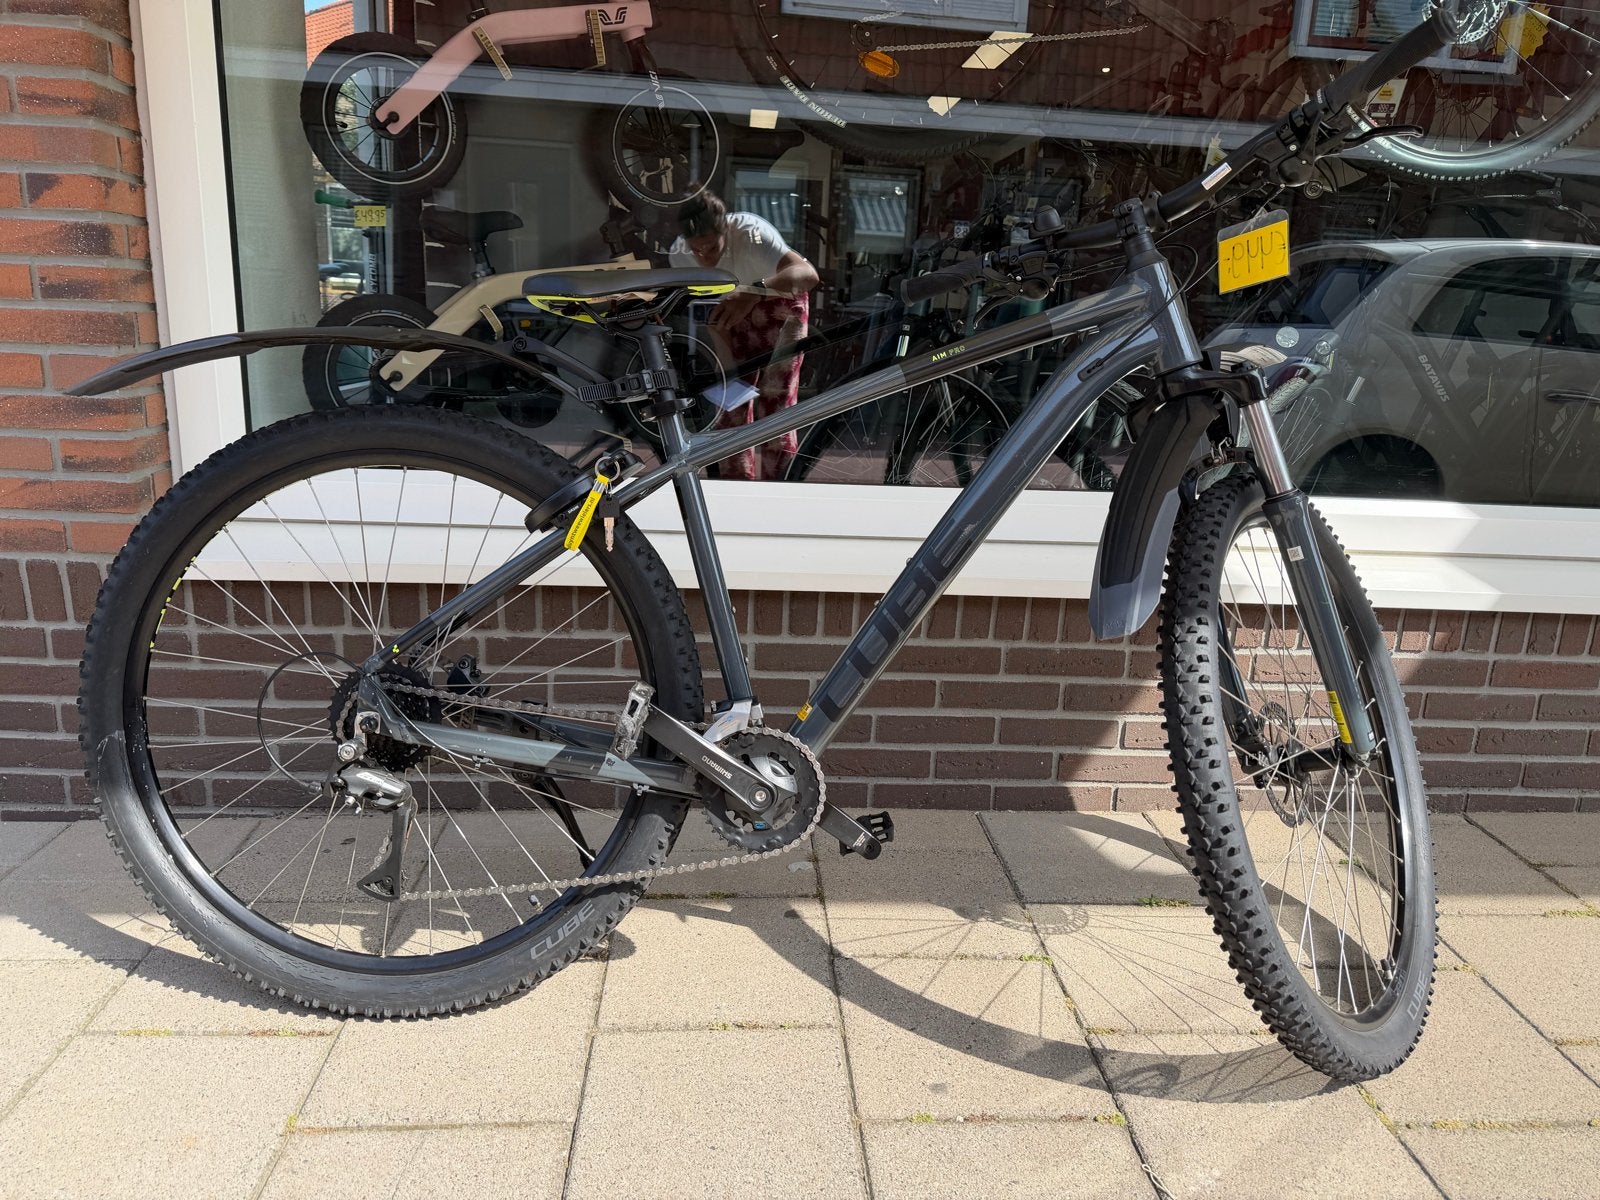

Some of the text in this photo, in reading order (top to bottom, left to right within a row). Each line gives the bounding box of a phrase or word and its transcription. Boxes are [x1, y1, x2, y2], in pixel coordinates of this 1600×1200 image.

[932, 345, 966, 362] AIM PRO
[1418, 354, 1450, 402] BATAVUS
[818, 518, 973, 722] CUBE
[701, 755, 733, 779] SHIMANO
[530, 899, 596, 960] CUBE
[1406, 969, 1429, 1021] CUBE
